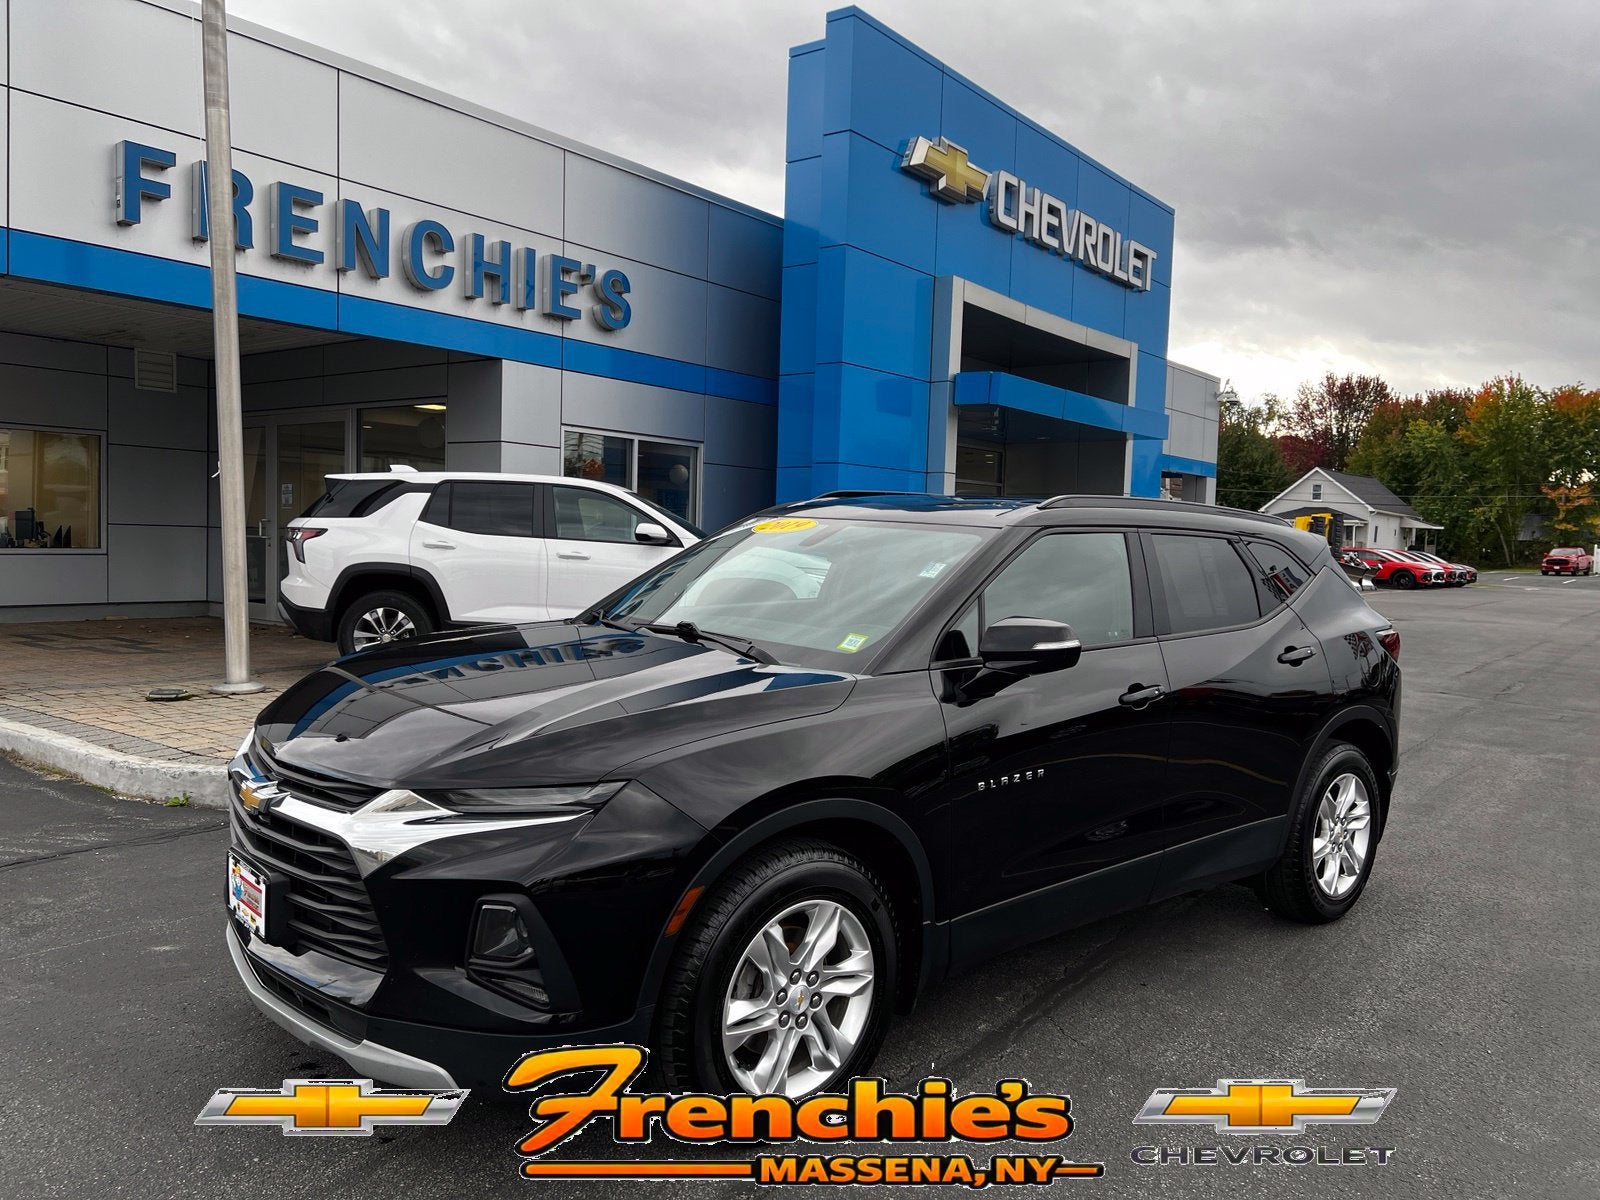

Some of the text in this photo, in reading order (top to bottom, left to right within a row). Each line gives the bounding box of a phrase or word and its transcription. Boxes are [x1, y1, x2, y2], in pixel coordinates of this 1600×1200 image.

[115, 140, 633, 331] FRENCHIE'S
[989, 169, 1157, 292] CHEVROLET
[977, 768, 1045, 792] BLAZER
